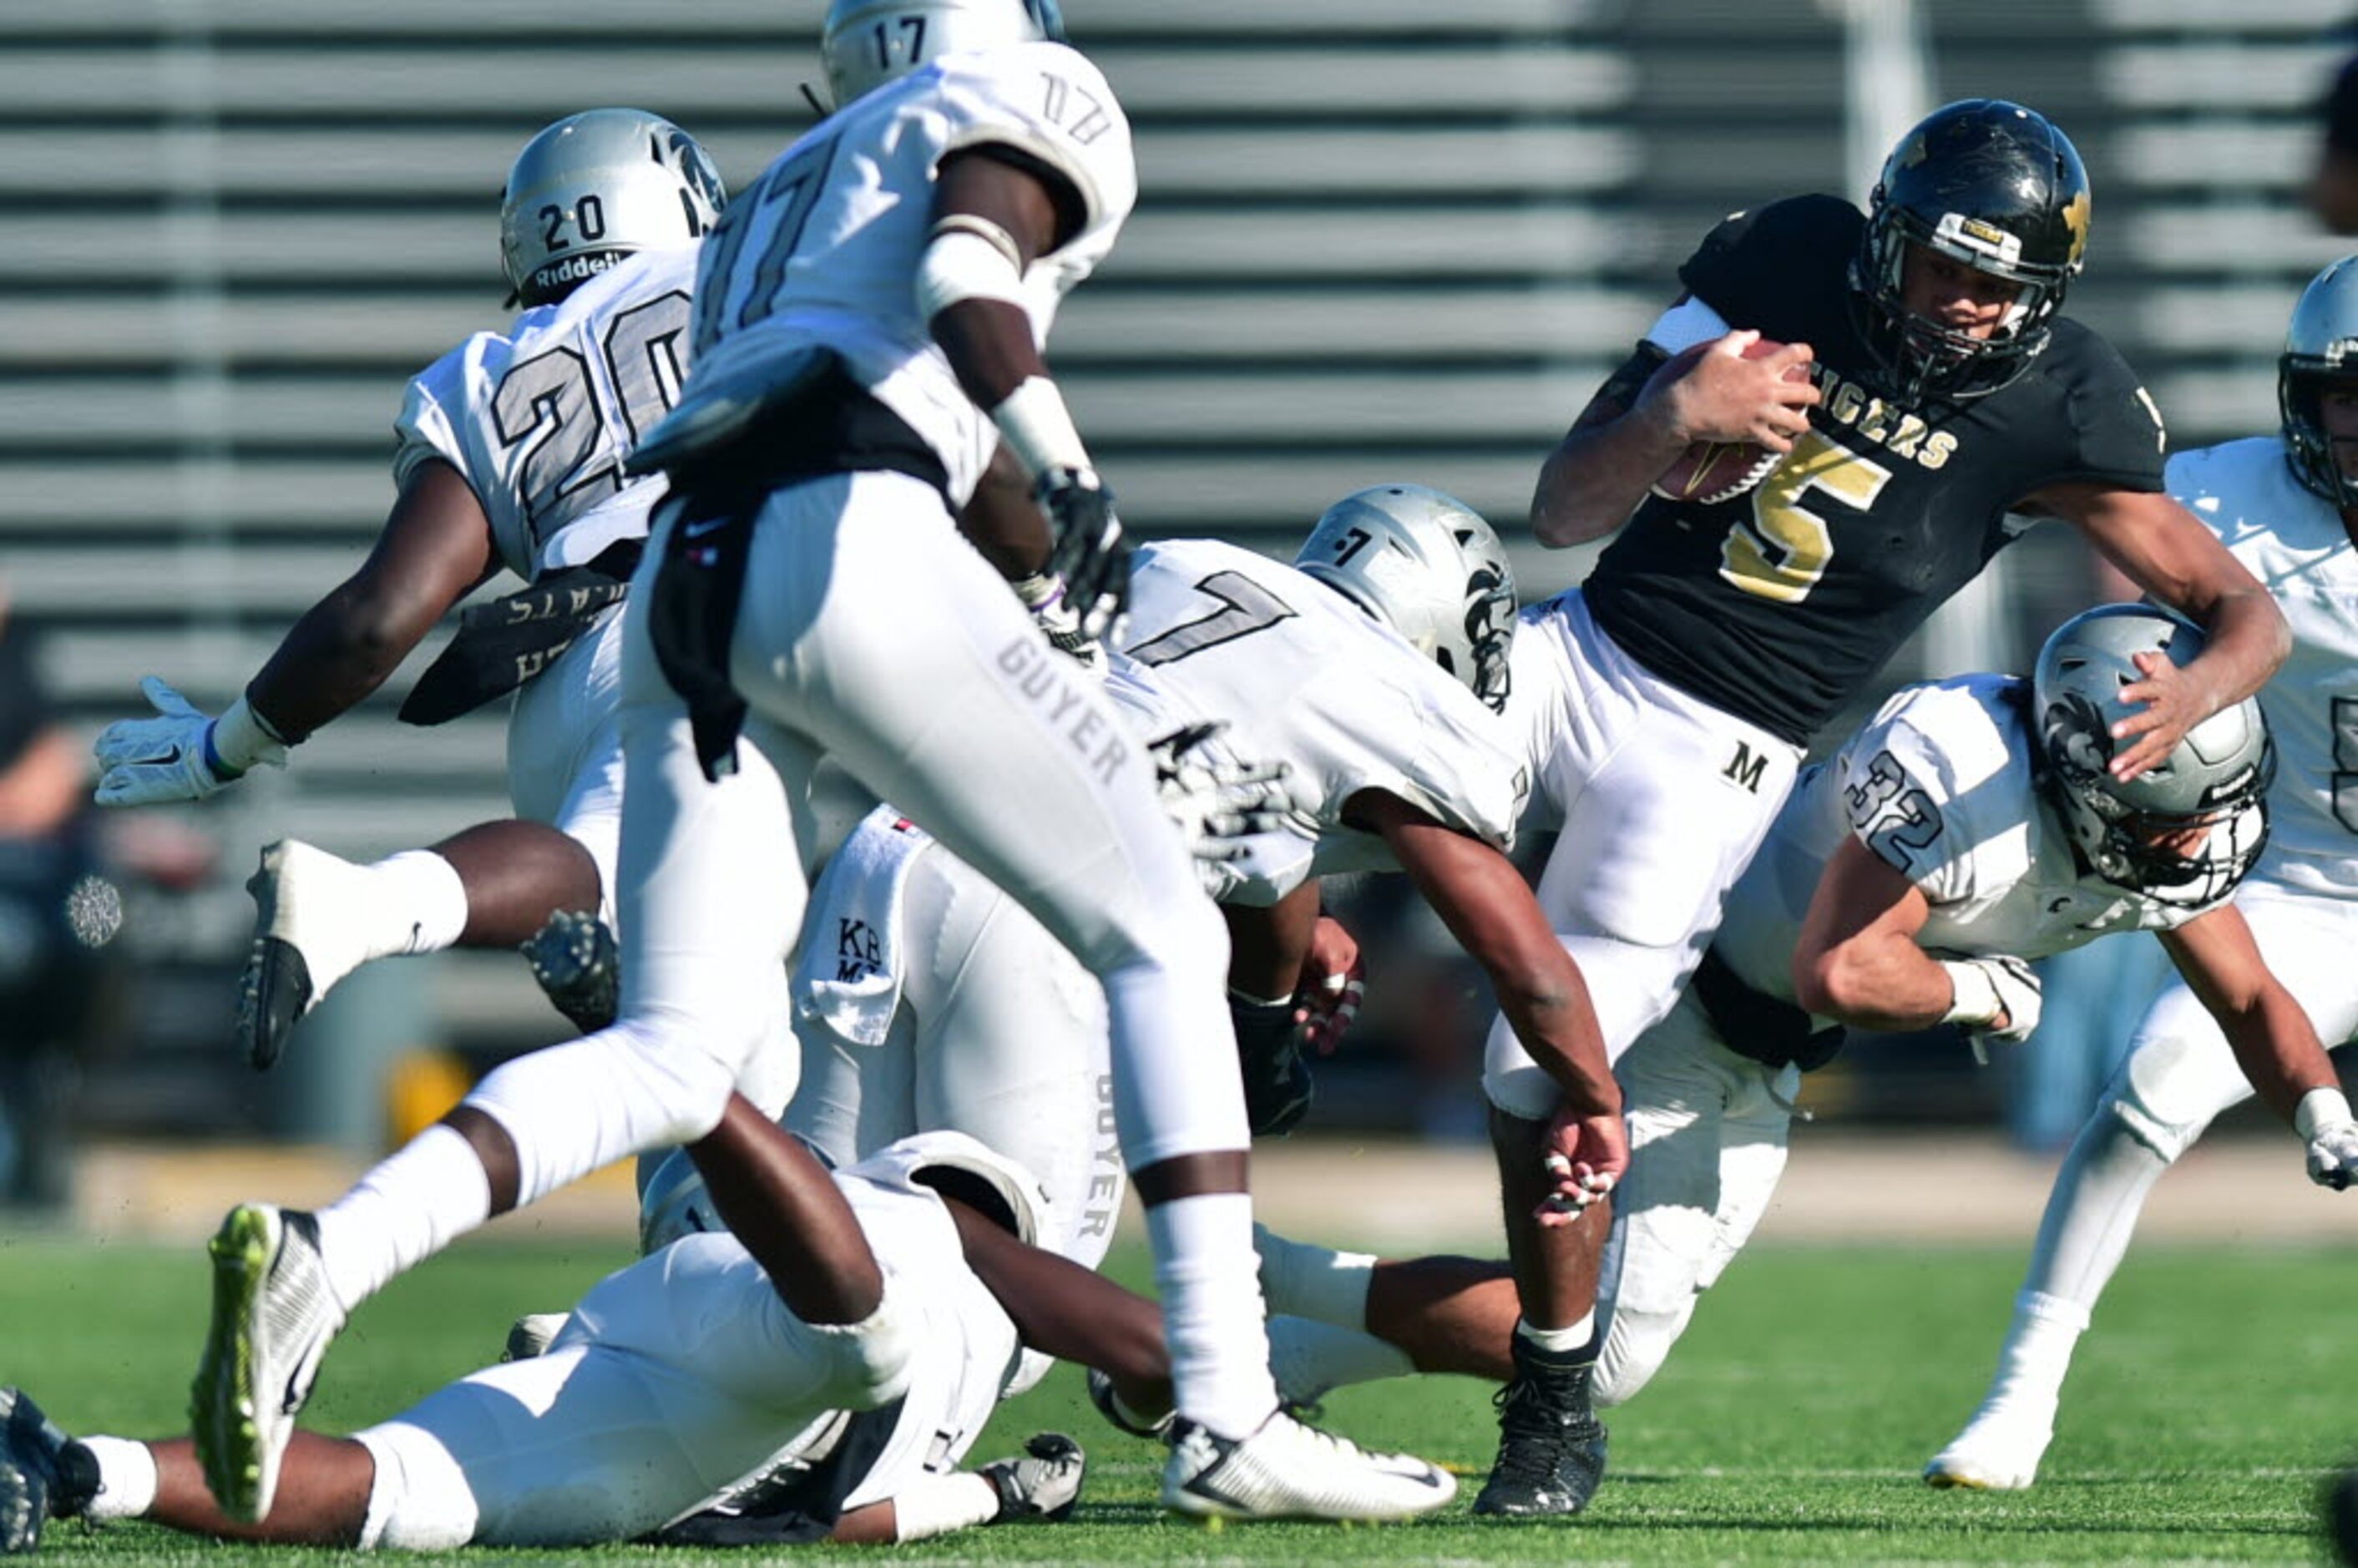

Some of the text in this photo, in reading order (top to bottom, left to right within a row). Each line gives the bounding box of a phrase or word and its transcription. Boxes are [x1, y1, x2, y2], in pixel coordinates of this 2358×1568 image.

[873, 14, 926, 70] 17
[1040, 70, 1112, 145] 17
[538, 194, 606, 253] 20
[695, 132, 843, 352] 17
[491, 289, 693, 544] 20
[1810, 360, 1959, 470] IGERS
[1334, 526, 1374, 569] 7
[1718, 427, 1893, 604] 5
[1125, 570, 1299, 668] 7
[996, 636, 1130, 786] GUYER
[1721, 739, 1769, 795] M
[1842, 750, 1945, 876] 32
[837, 917, 882, 966] KB
